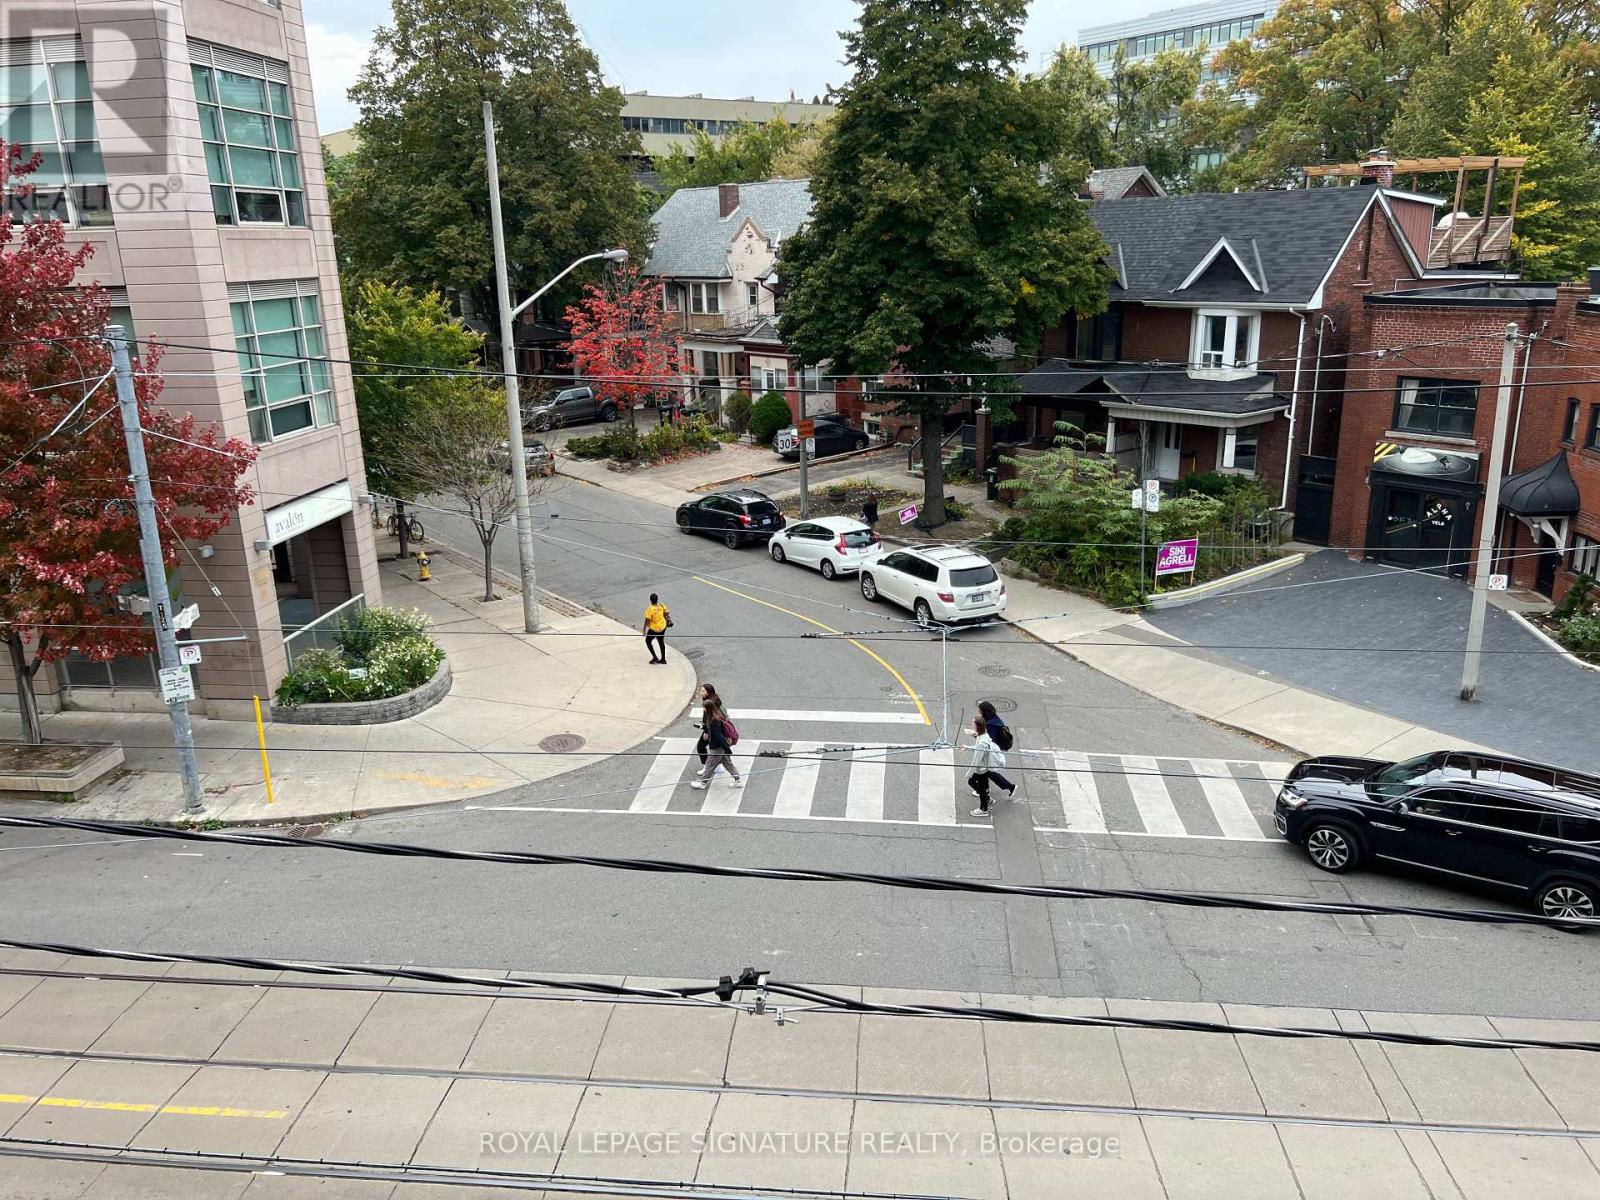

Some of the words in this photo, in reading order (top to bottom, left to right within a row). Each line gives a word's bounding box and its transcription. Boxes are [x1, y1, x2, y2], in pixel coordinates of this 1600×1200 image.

[780, 439, 791, 450] 30
[1426, 503, 1452, 521] ALPHA
[1169, 546, 1186, 556] SIRI
[1160, 554, 1193, 567] AGRELL
